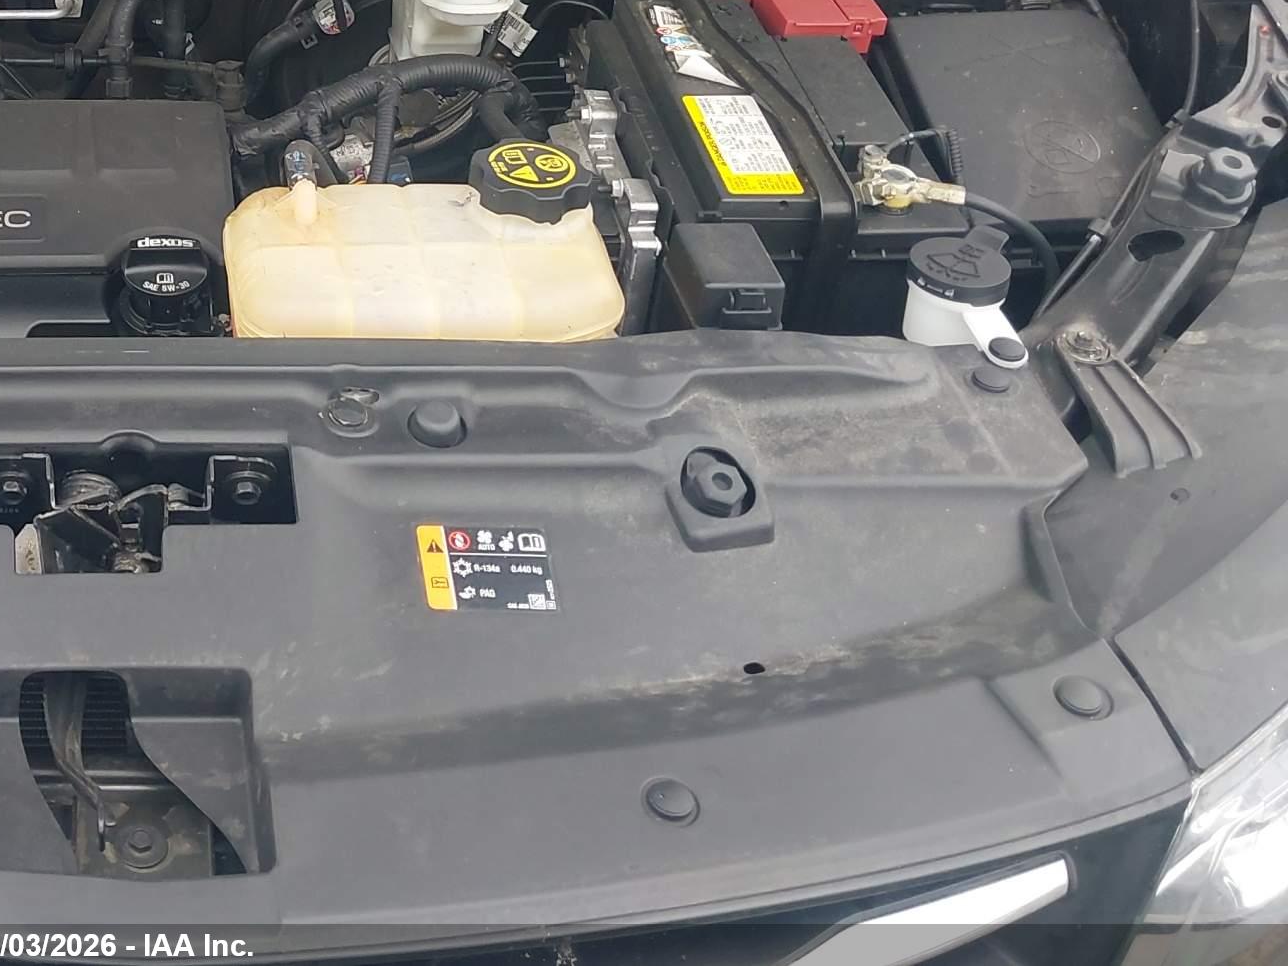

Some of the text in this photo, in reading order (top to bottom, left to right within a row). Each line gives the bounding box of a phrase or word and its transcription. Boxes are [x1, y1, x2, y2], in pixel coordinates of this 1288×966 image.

[137, 236, 194, 248] dexos
[142, 280, 190, 292] SAE 5W-30
[473, 564, 501, 573] R-134a
[532, 565, 543, 575] kg
